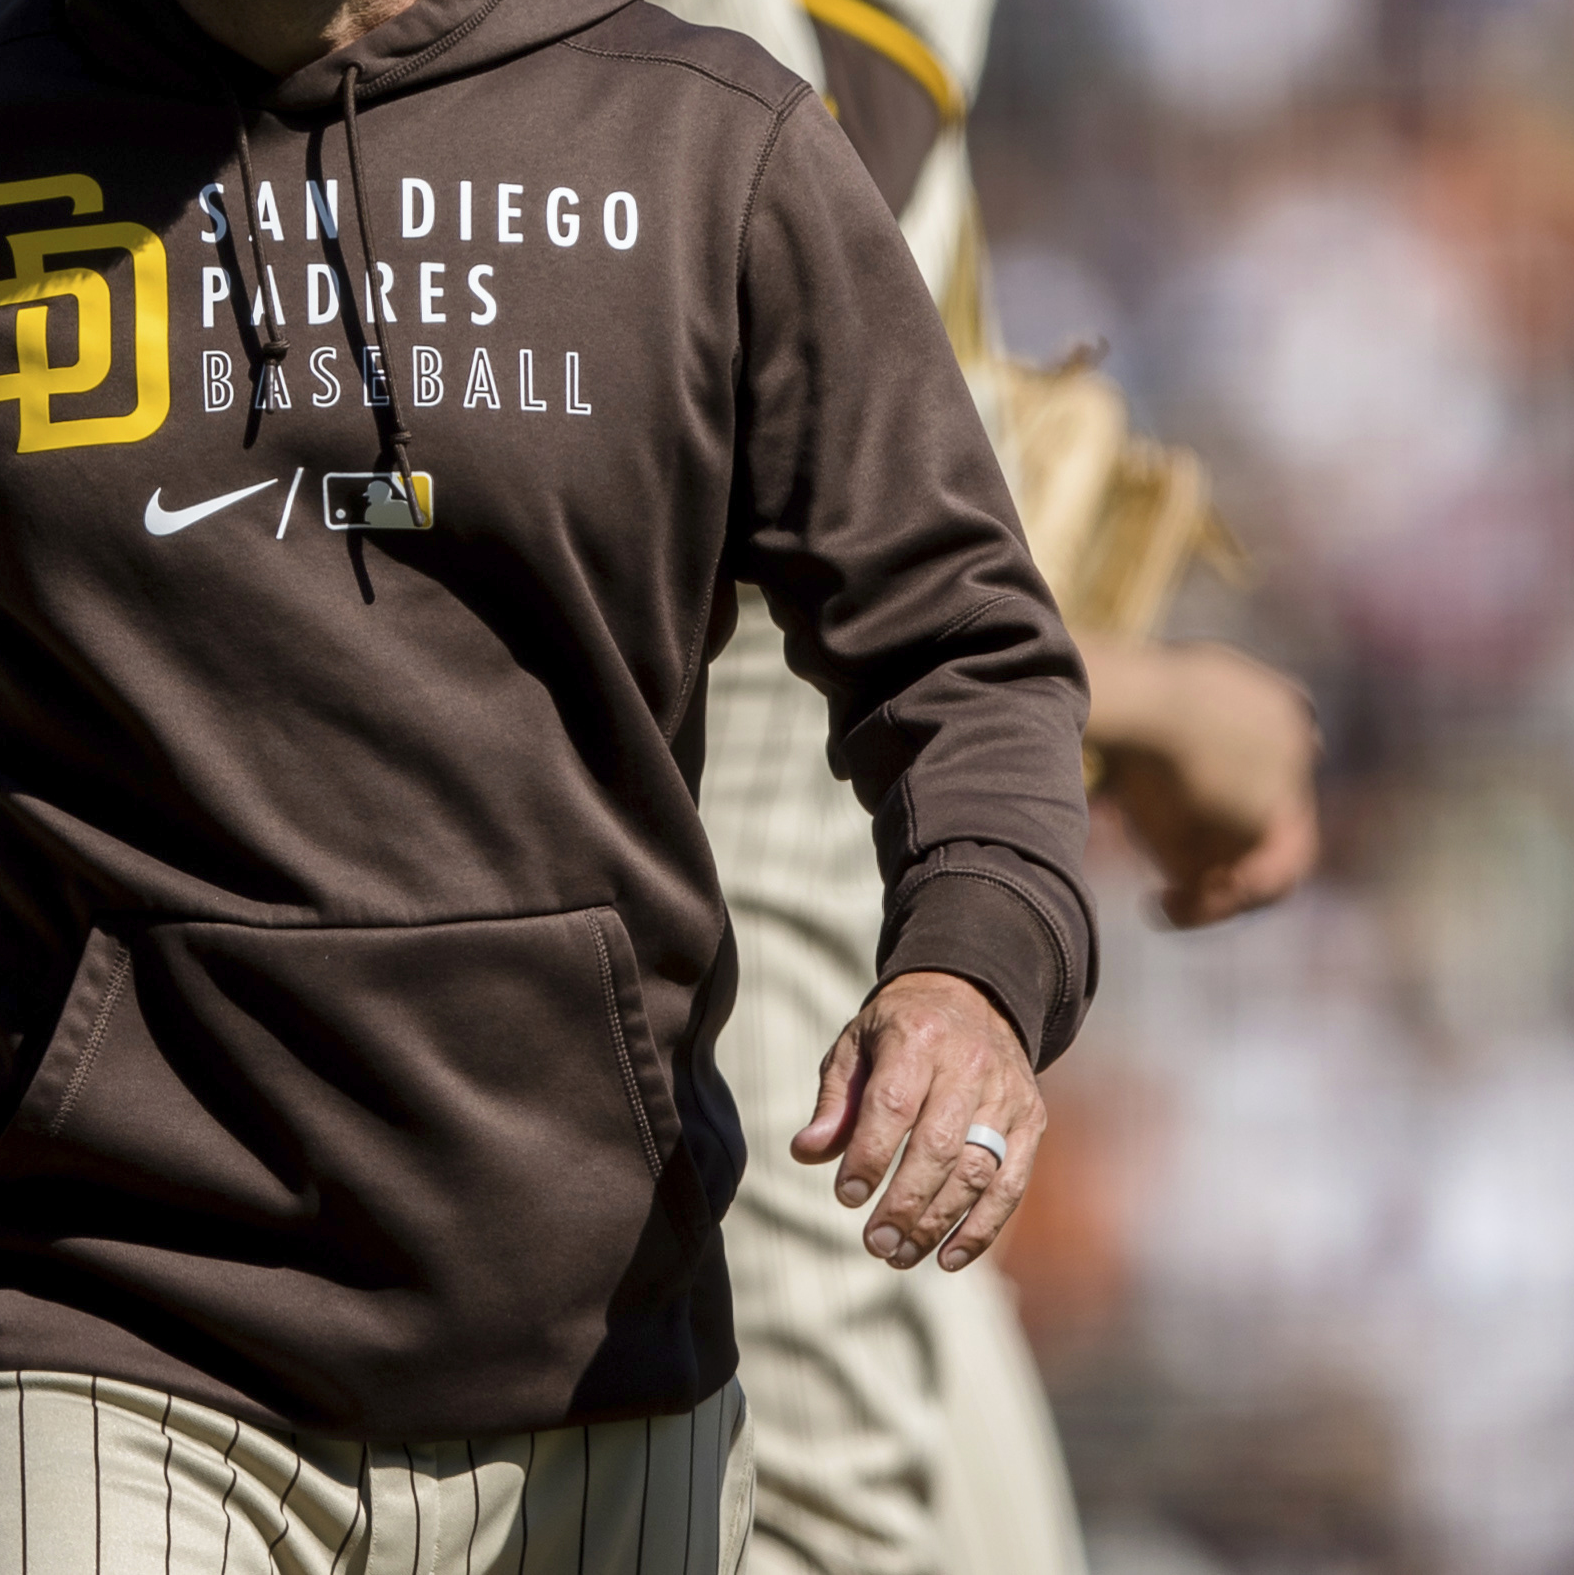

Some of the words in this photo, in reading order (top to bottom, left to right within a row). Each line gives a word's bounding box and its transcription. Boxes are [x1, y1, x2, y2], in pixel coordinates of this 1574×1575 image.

[199, 179, 339, 243] SAN
[401, 177, 638, 250] DIEGO
[202, 261, 497, 328] PADRES
[202, 345, 592, 415] BASEBALL
